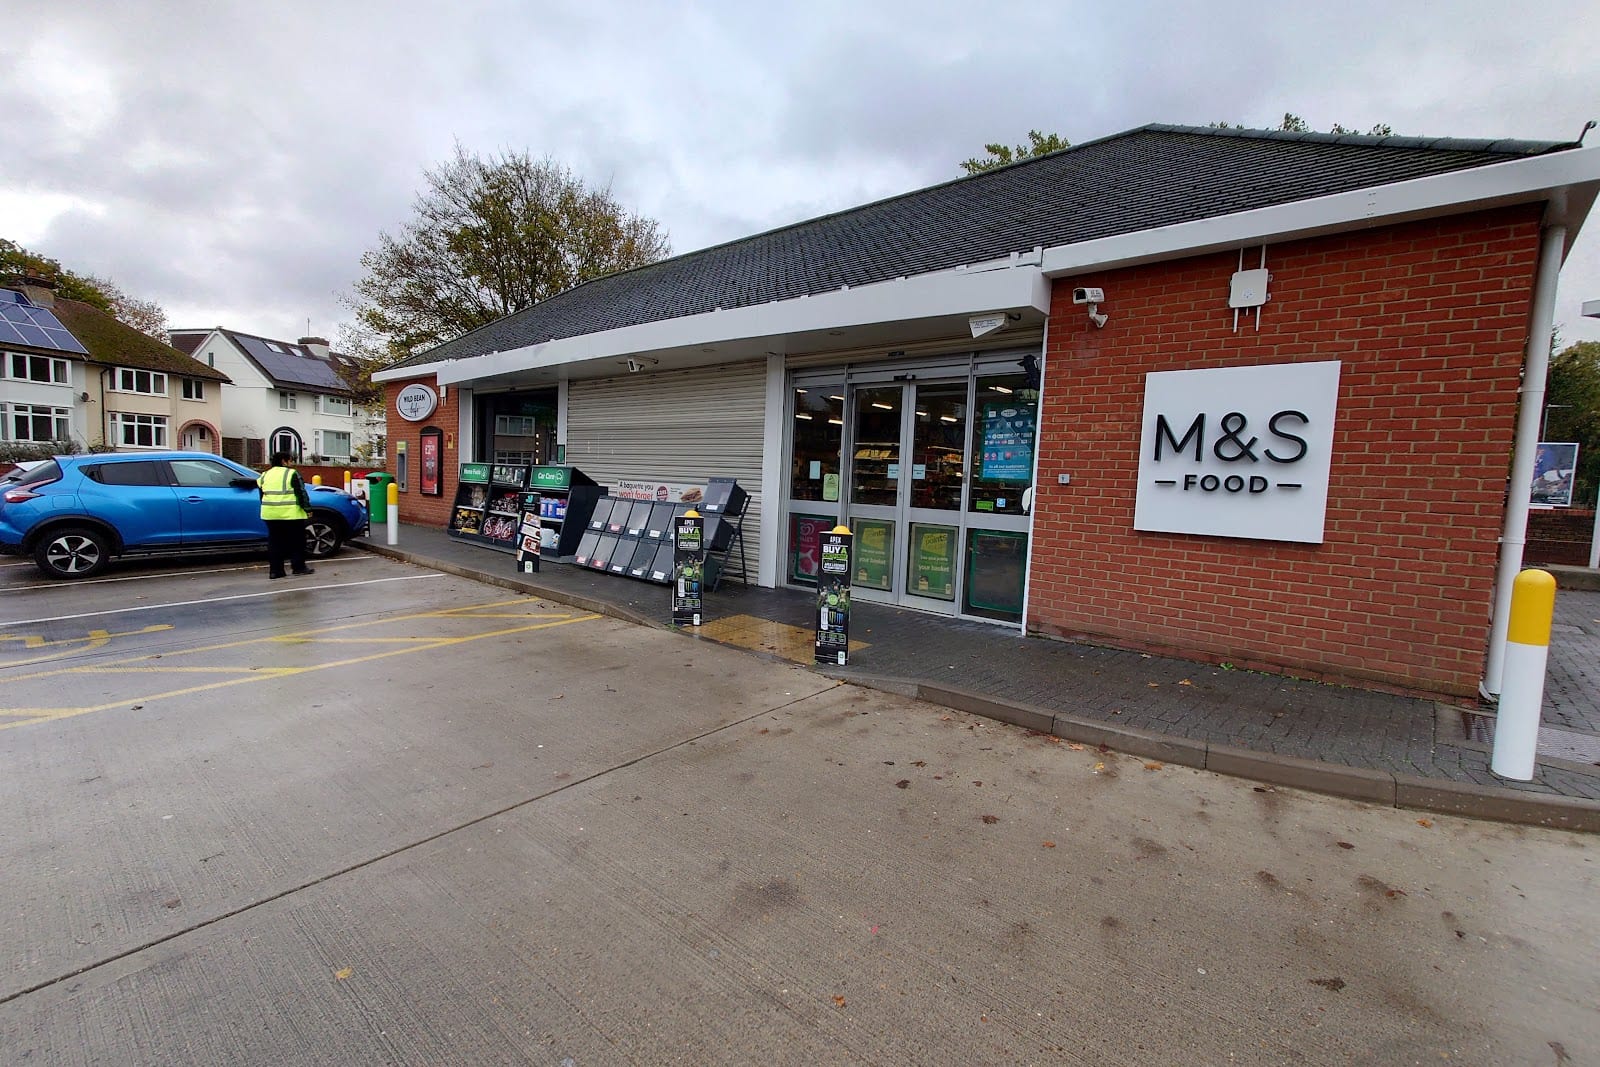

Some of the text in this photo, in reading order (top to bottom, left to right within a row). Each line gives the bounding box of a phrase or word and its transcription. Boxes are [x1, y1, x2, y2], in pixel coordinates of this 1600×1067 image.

[403, 394, 426, 403] WILD BEAN
[1154, 410, 1309, 463] M&S
[537, 472, 546, 480] Car
[644, 483, 653, 492] you
[1183, 474, 1269, 493] FOOD
[619, 490, 634, 499] won't
